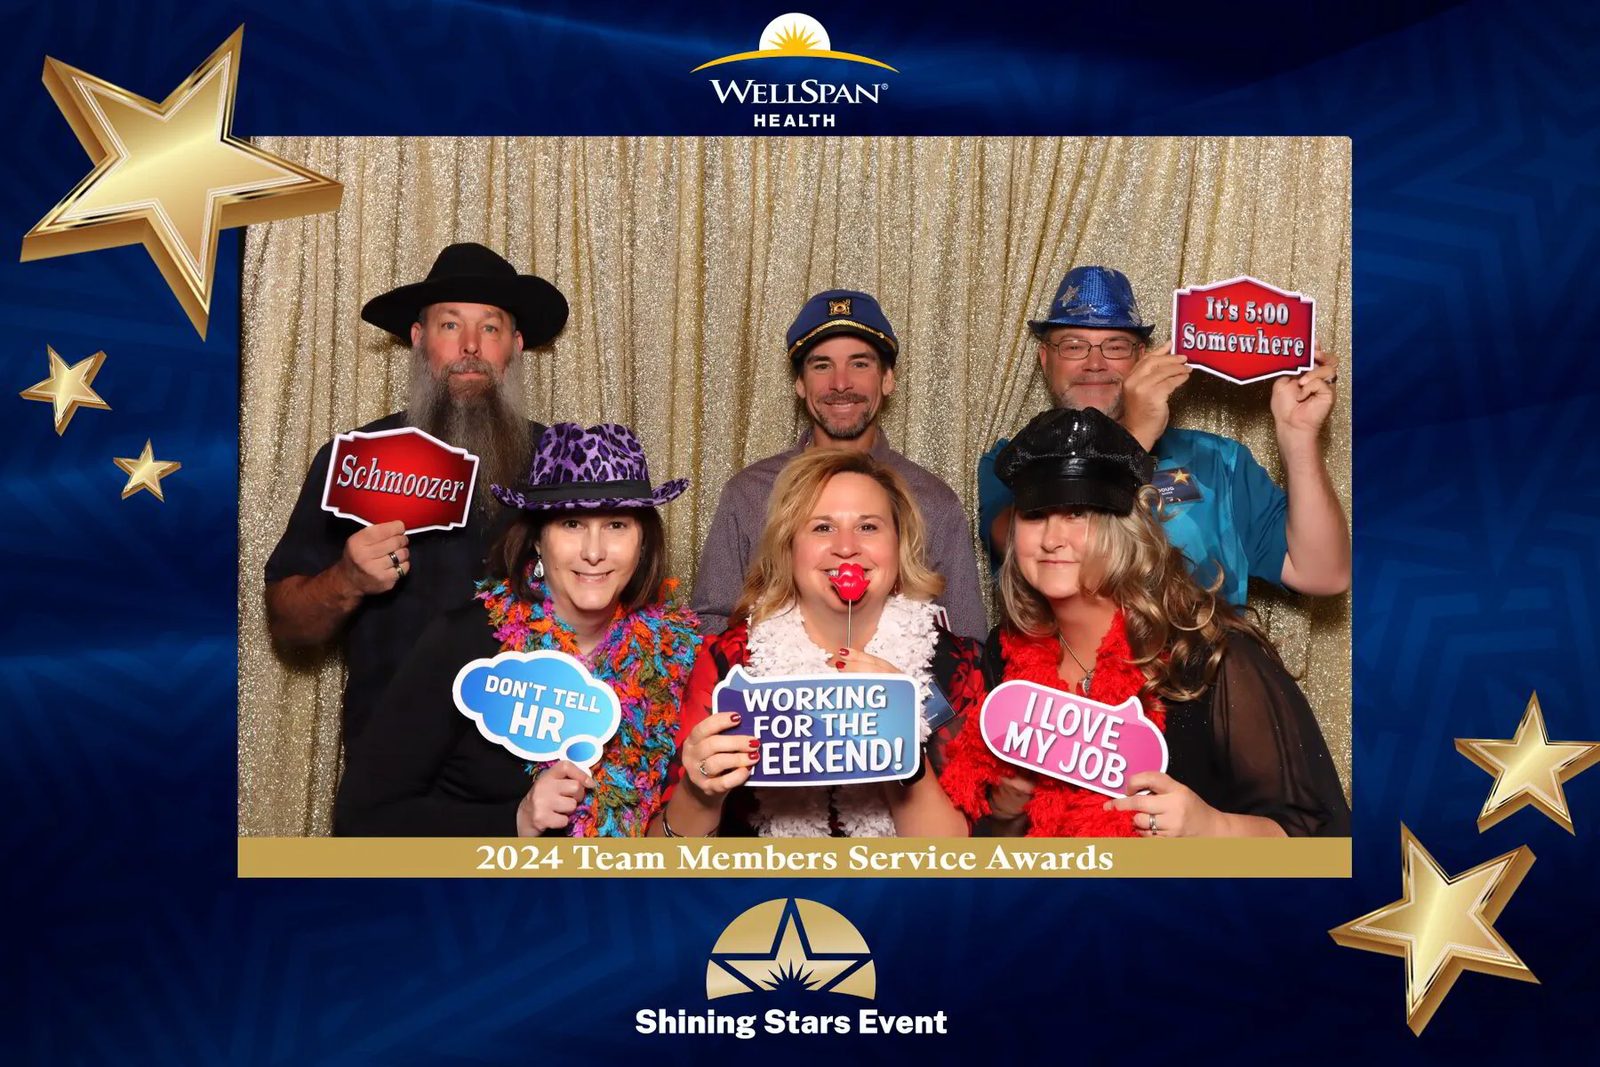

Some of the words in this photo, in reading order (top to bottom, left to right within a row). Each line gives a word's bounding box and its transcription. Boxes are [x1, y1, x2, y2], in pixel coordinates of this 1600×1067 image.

[1205, 296, 1239, 322] It's
[1244, 301, 1289, 325] 5:00
[1182, 322, 1305, 357] Somewhere
[336, 454, 465, 502] Schmoozer
[485, 675, 547, 702] DON'T
[553, 688, 600, 713] TELL
[742, 684, 887, 713] WORKING
[509, 701, 565, 743] HR
[754, 715, 813, 739] FOR
[821, 712, 877, 737] THE
[1023, 691, 1038, 724] I
[1039, 696, 1124, 751] LOVE
[750, 737, 904, 776] EEKEND!
[1002, 720, 1057, 764] MY
[1058, 741, 1127, 788] JOB
